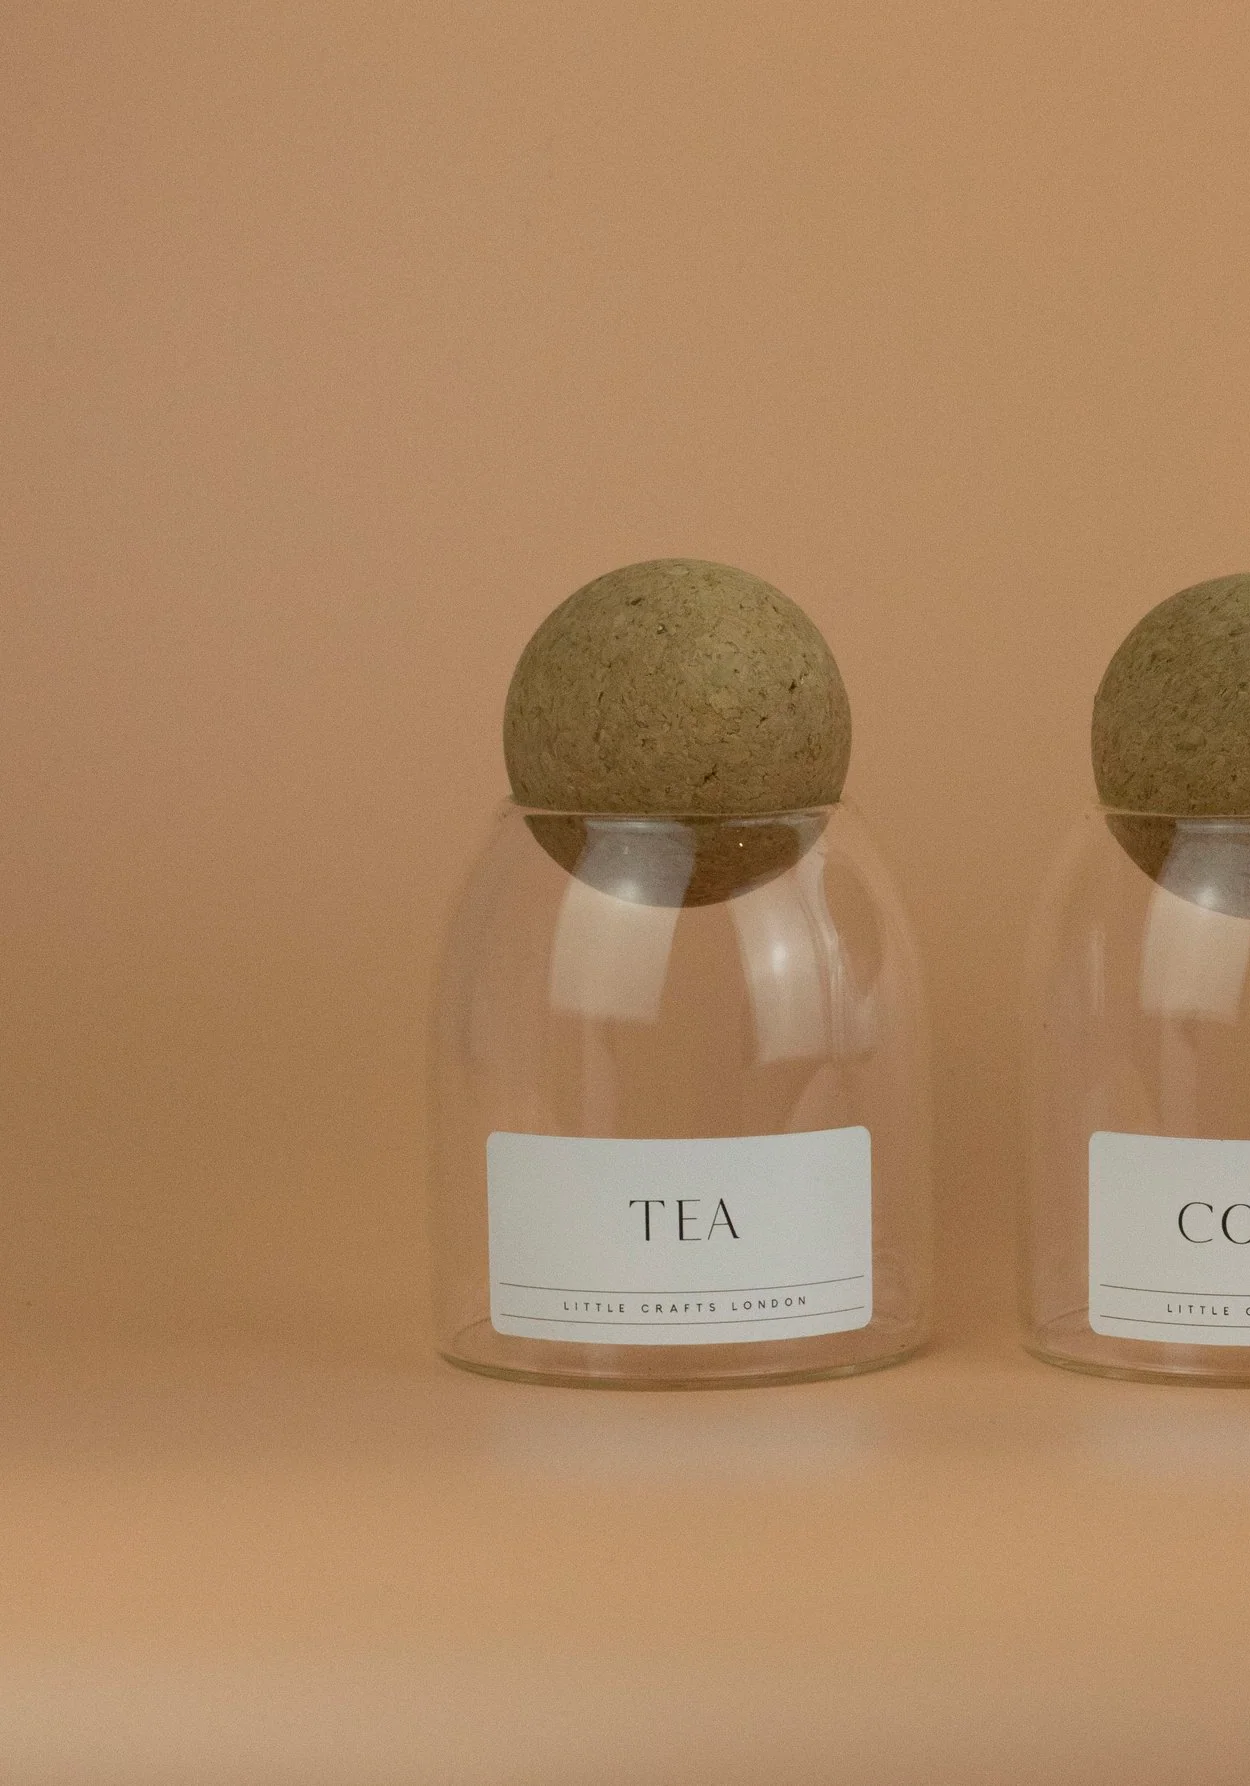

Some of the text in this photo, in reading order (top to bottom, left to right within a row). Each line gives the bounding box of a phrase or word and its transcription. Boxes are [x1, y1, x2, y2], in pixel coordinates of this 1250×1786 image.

[628, 1197, 741, 1242] TEA
[563, 1296, 807, 1314] LITTLE CRAFTS LONDON
[1167, 1303, 1230, 1316] LITTLE
